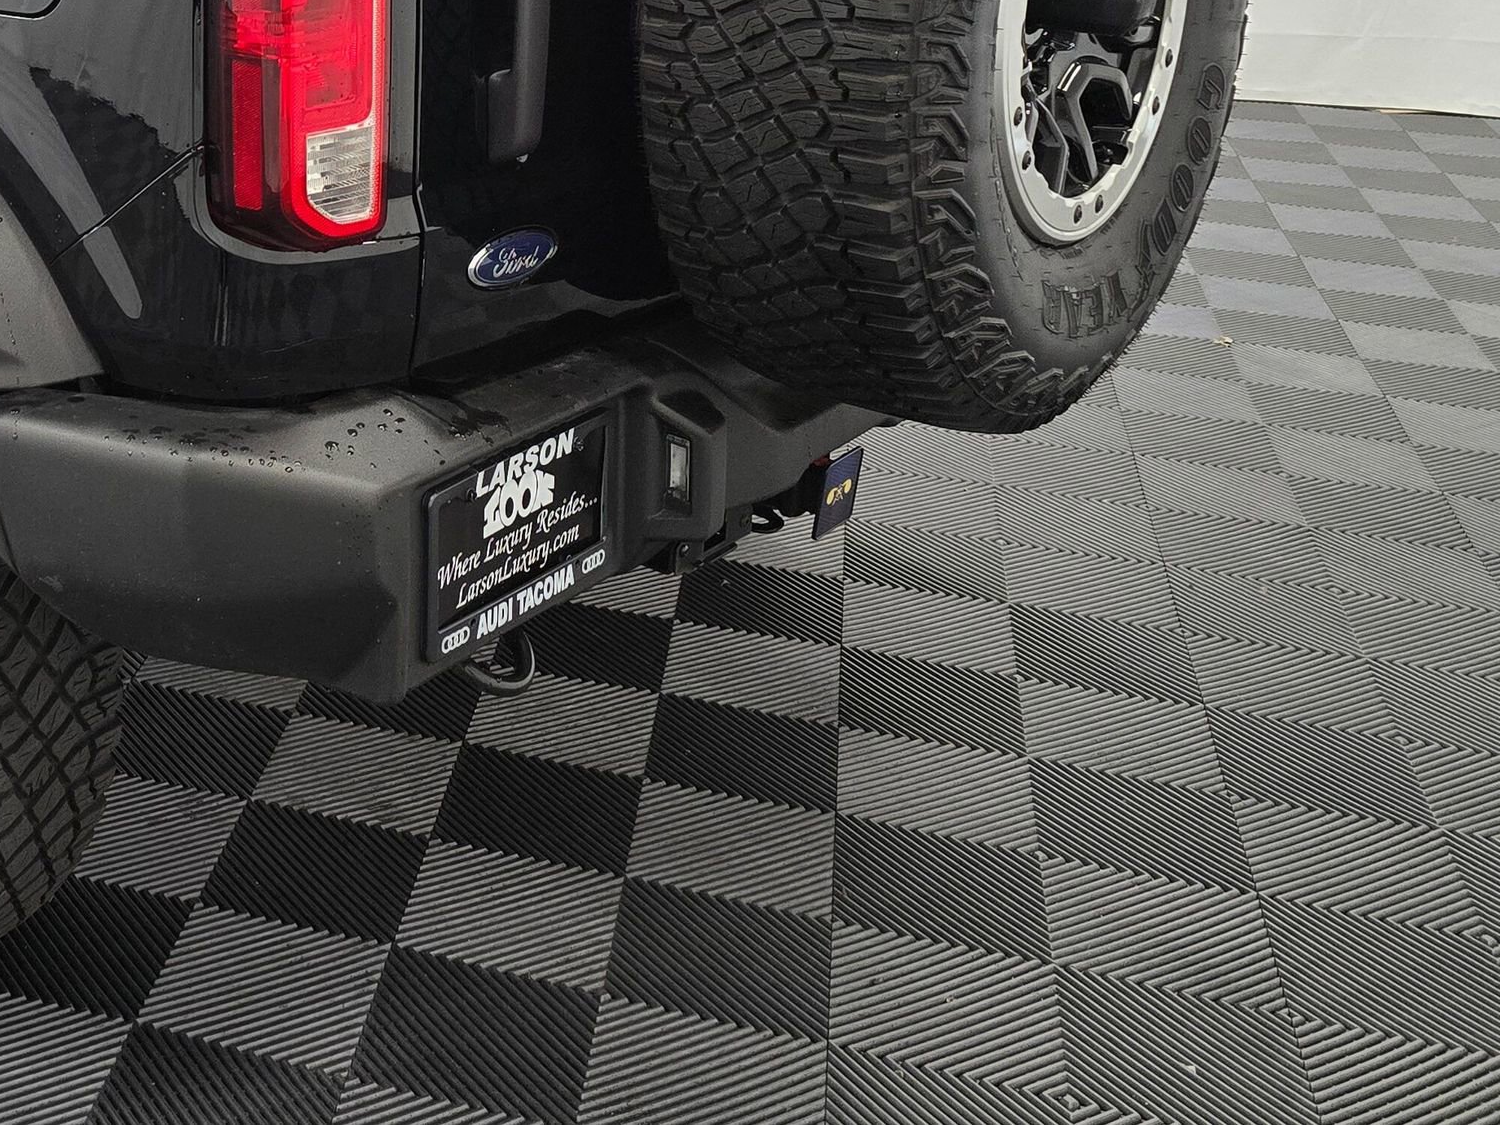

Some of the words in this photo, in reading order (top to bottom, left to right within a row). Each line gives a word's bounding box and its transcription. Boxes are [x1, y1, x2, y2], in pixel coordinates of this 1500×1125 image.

[492, 245, 540, 278] Ford
[475, 428, 575, 499] LARSON
[437, 551, 481, 589] Where
[483, 521, 533, 563] Luxury
[535, 490, 598, 533] Resides...
[456, 524, 580, 609] LarsonLuxury.com
[476, 597, 513, 639] AUDI
[516, 563, 575, 615] TACOMA
